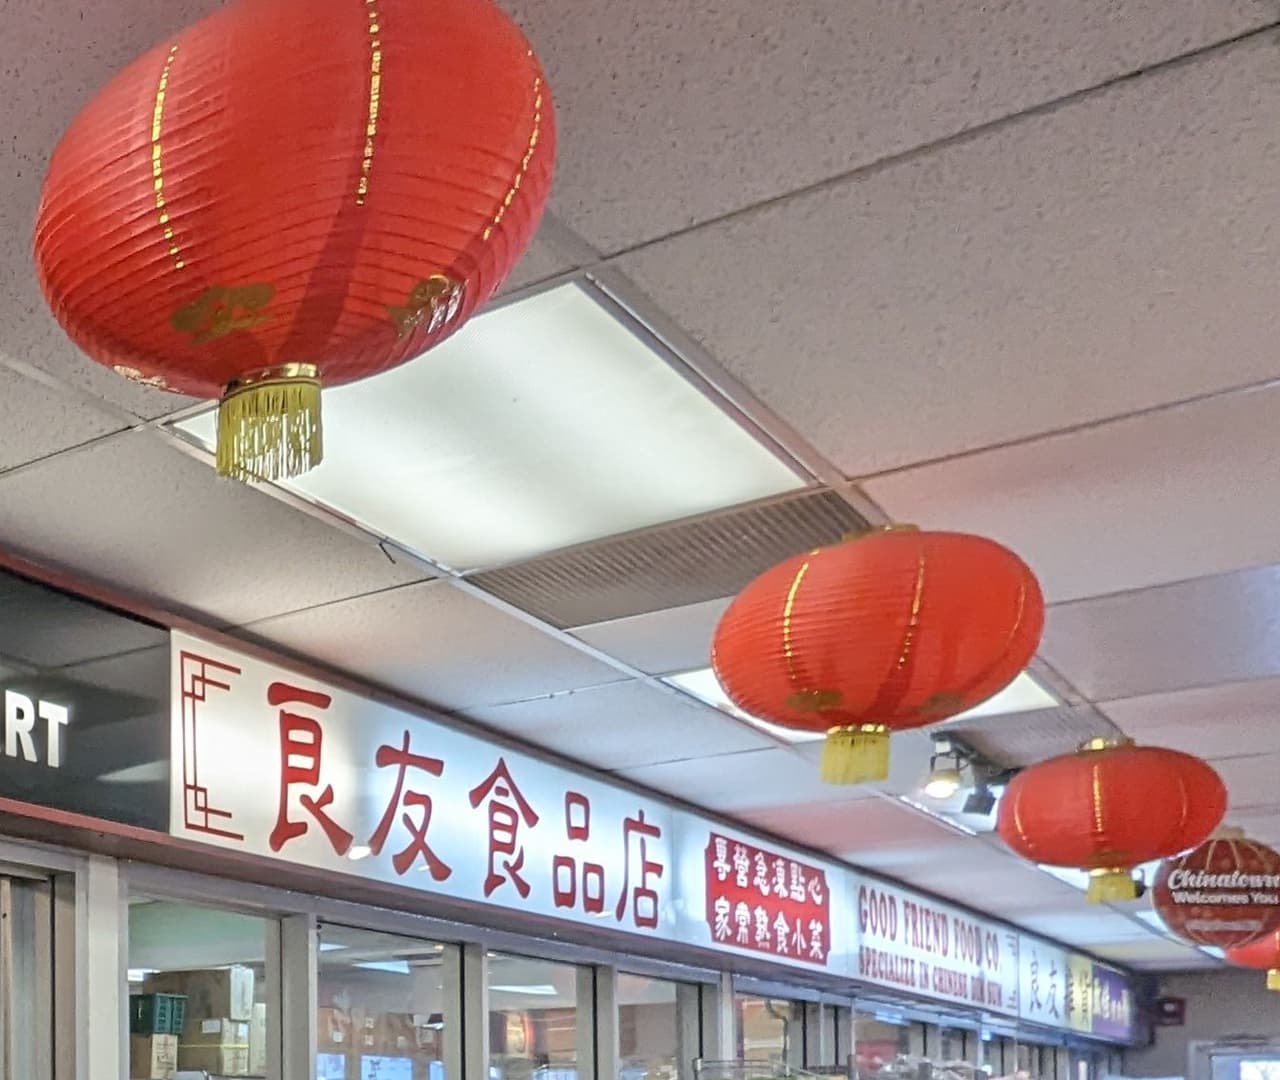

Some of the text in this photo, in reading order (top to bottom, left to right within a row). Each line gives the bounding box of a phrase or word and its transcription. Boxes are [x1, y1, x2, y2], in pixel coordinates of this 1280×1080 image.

[267, 681, 664, 929] 良友食品店
[858, 884, 898, 941] GOOD
[903, 900, 949, 957] FRIEND
[954, 918, 983, 966] FOOD
[858, 944, 916, 988] SPECIALIZE
